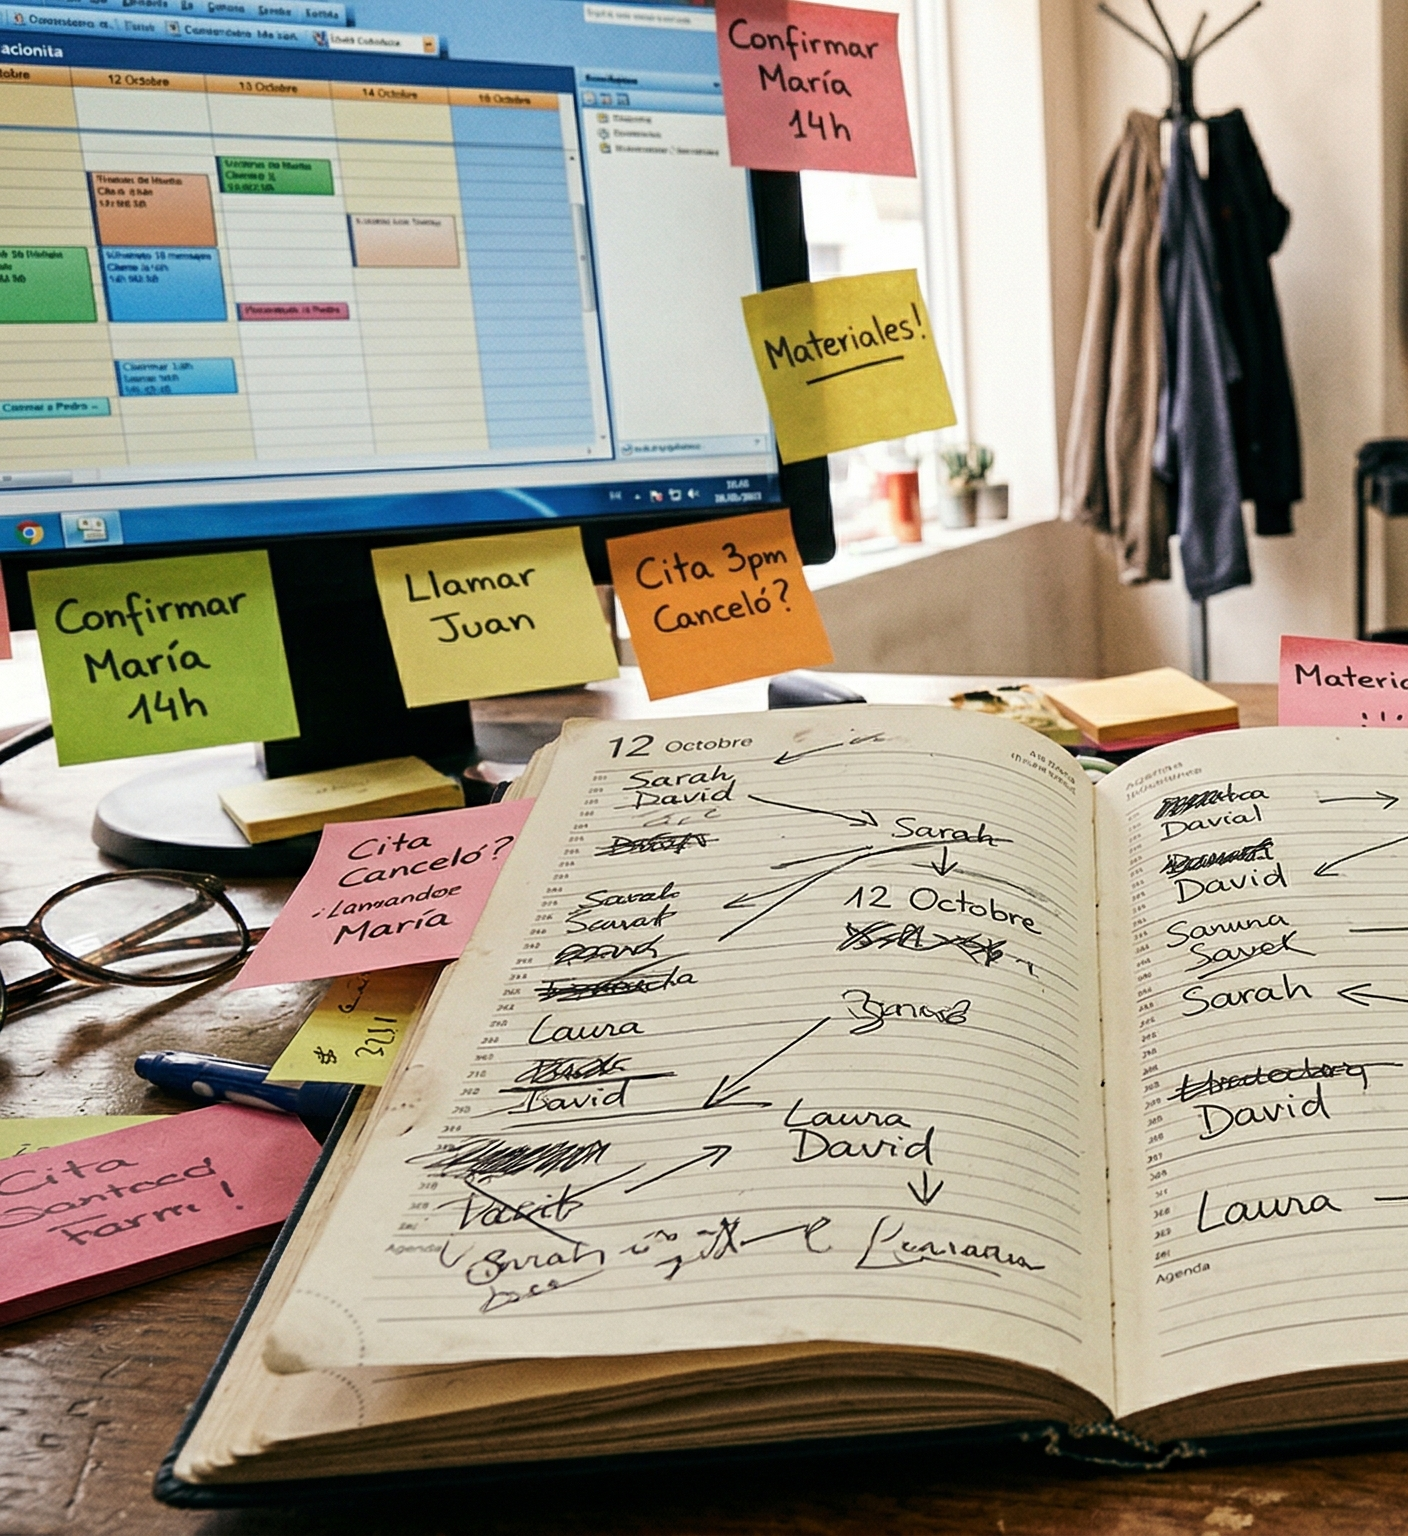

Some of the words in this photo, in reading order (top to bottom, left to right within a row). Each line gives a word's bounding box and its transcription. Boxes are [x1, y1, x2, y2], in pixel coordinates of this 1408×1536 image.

[728, 18, 879, 61] Confirmar
[108, 74, 122, 85] 12
[758, 63, 852, 97] María
[788, 109, 851, 142] 14h
[764, 302, 926, 370] Materiales!
[635, 552, 714, 590] Cita
[721, 542, 788, 580] 3pm
[405, 567, 536, 603] Llamar
[55, 592, 247, 637] Confirmar
[653, 578, 793, 634] Canceló?
[430, 611, 536, 644] Juan
[84, 639, 212, 684] María
[128, 687, 208, 724] 14h
[608, 734, 655, 759] 12
[665, 735, 753, 754] Octobre
[614, 779, 736, 810] David
[623, 765, 735, 791] Sarah
[347, 832, 433, 861] Cita
[891, 816, 1001, 847] Sarah
[338, 835, 515, 888] Canceló?
[1174, 863, 1288, 904] David
[332, 908, 452, 945] María
[843, 885, 892, 909] 12
[909, 886, 1042, 935] Octobre
[1182, 974, 1313, 1016] Sarah
[528, 1014, 645, 1044] Laura
[508, 1078, 631, 1114] David
[783, 1098, 912, 1127] Laura
[1193, 1082, 1331, 1141] David
[789, 1126, 935, 1165] David
[0, 1157, 138, 1196] Cita
[1197, 1190, 1342, 1233] Laura
[1155, 1260, 1211, 1285] Agenda
